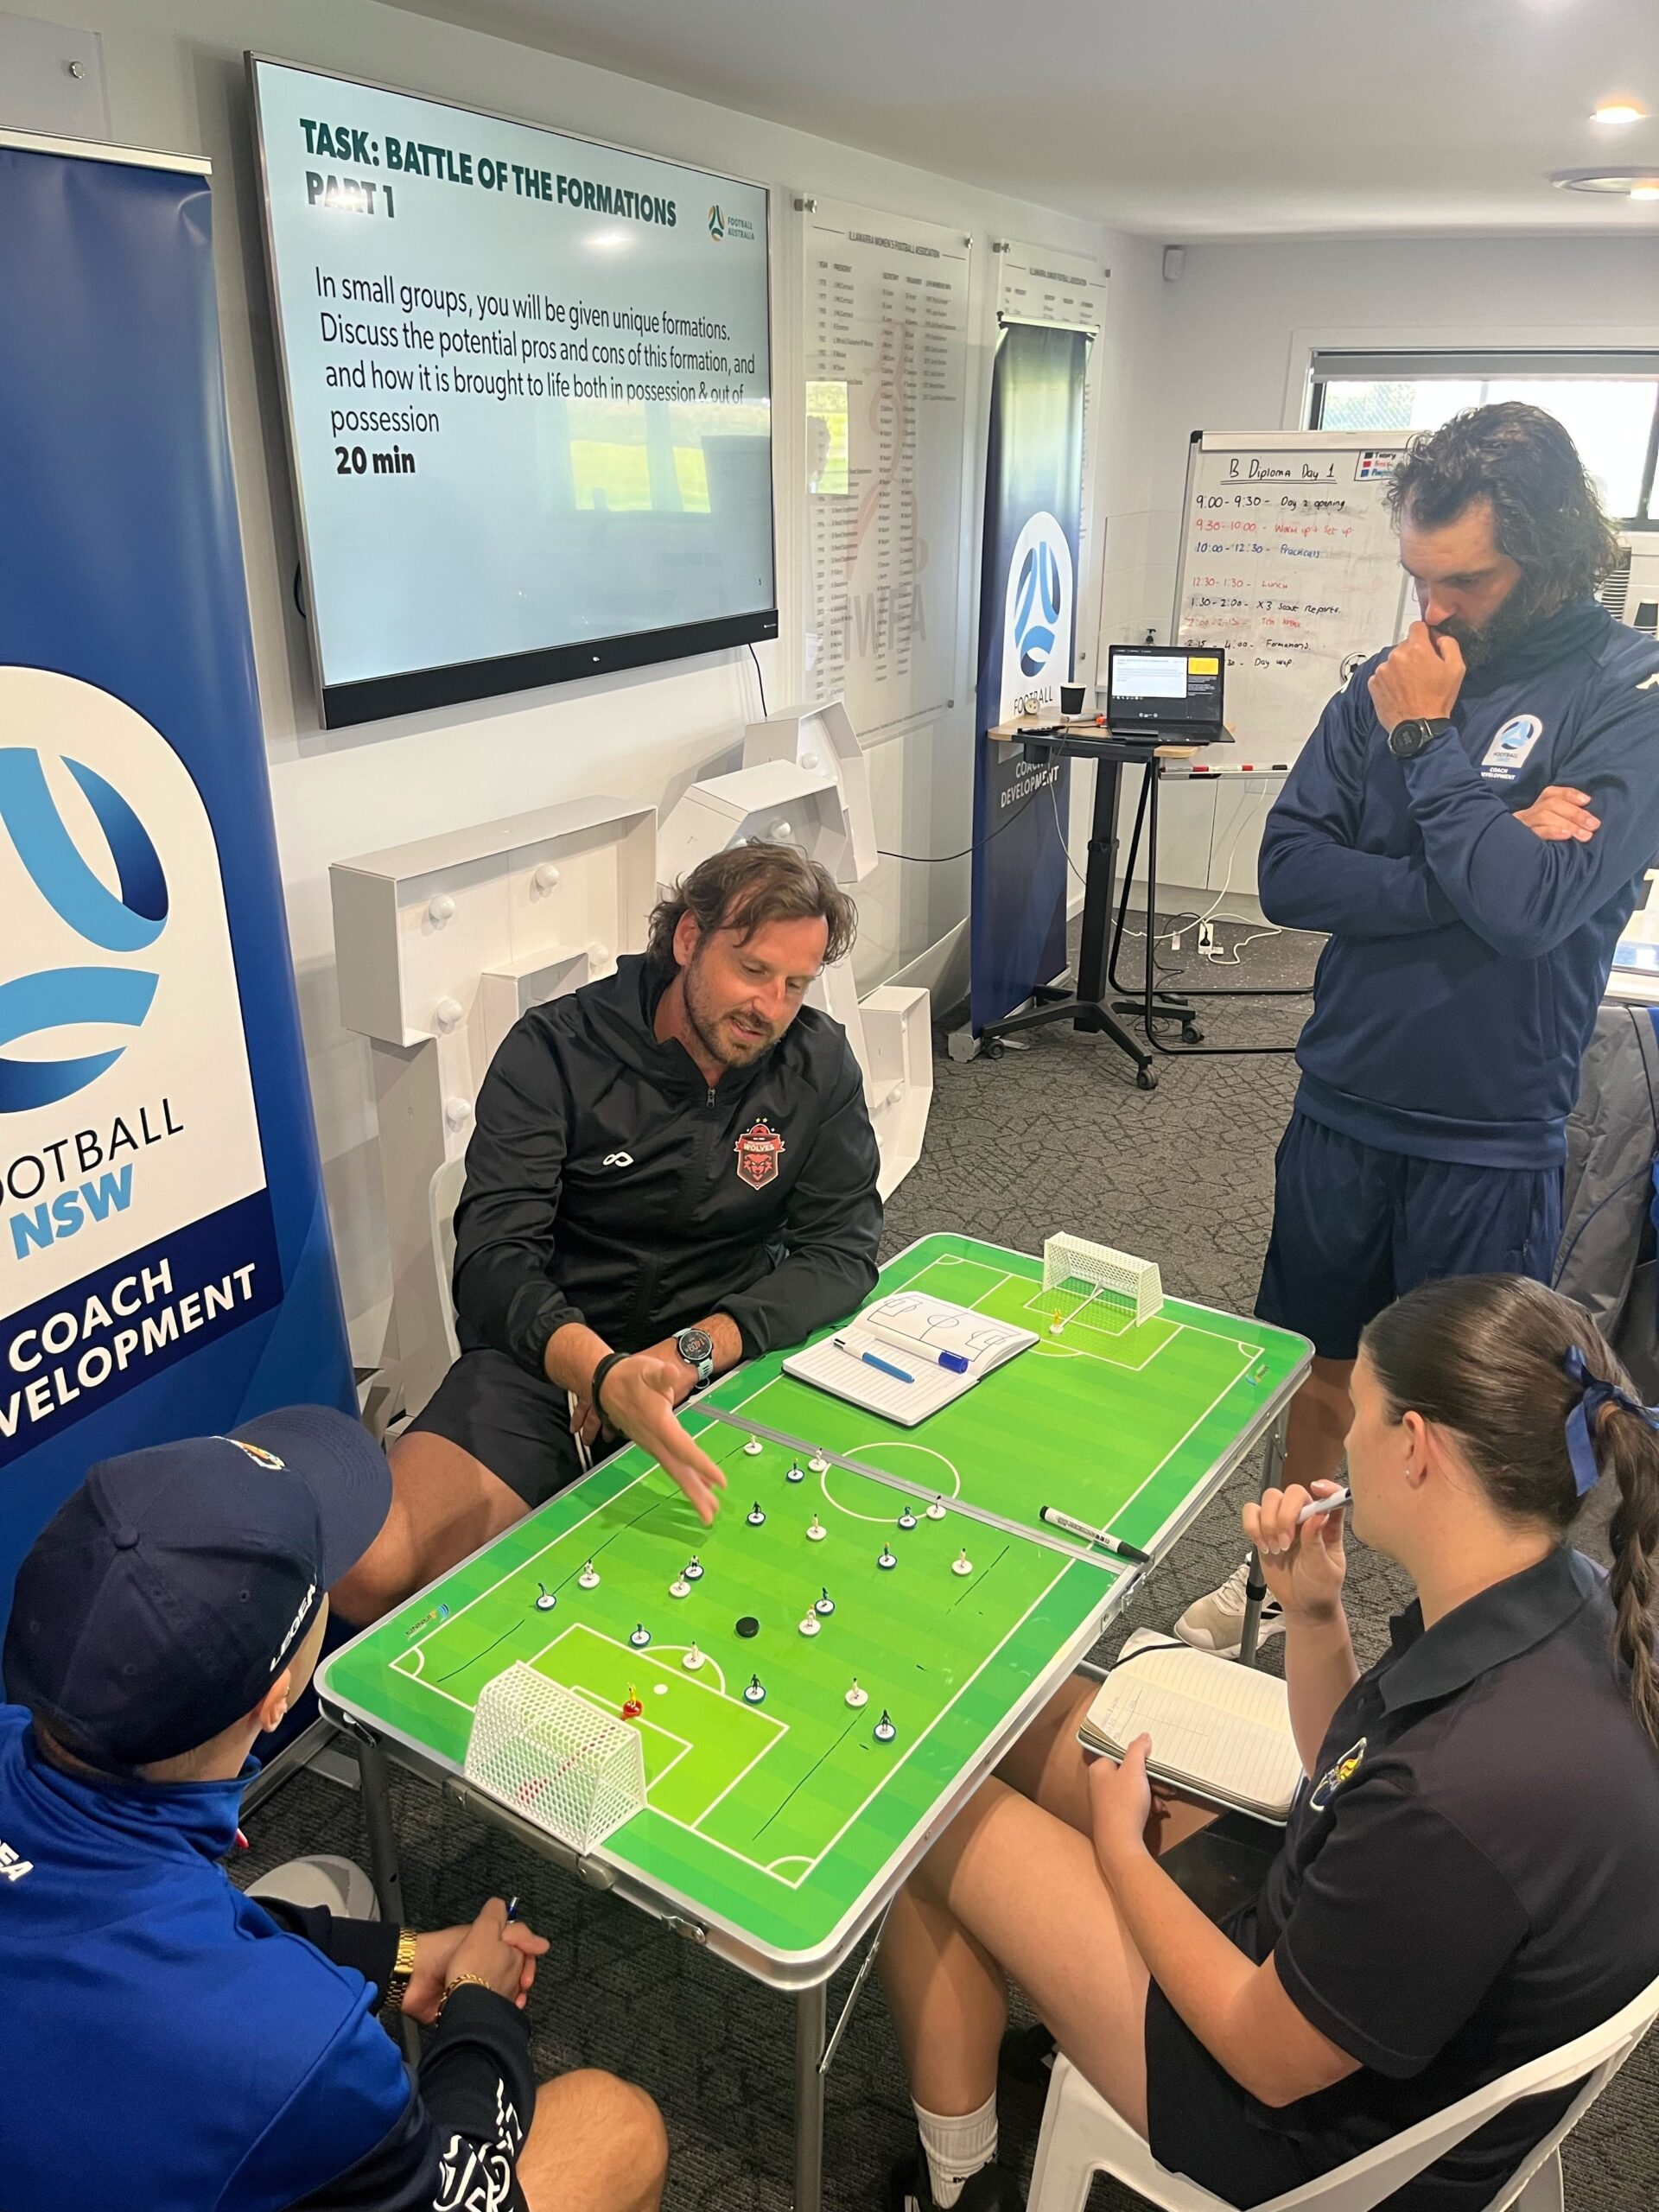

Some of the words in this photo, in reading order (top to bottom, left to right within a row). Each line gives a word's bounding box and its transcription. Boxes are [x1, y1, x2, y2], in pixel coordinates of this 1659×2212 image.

[300, 118, 380, 167] TASK:
[385, 137, 474, 186] BATTLE
[478, 157, 508, 192] OF
[512, 164, 553, 202] THE
[556, 175, 677, 227] FORMATIONS
[305, 170, 377, 215] PART
[383, 184, 395, 219] 1
[728, 217, 753, 231] FOOTBALL
[728, 227, 755, 240] AUSTRALIA
[315, 266, 336, 298] In
[342, 275, 395, 304] small
[400, 285, 473, 318] groups,
[476, 294, 509, 321] you
[512, 294, 541, 321] will
[545, 296, 565, 322] be
[569, 300, 609, 330] given
[613, 307, 659, 337] unique
[662, 311, 730, 341] formations.
[321, 311, 398, 347] Discuss
[403, 321, 434, 350] the
[439, 328, 517, 358] potential
[521, 338, 556, 363] pros
[560, 338, 588, 363] and
[592, 345, 625, 365] cons
[628, 342, 642, 366] of
[644, 344, 667, 368] this
[670, 346, 732, 376] formation,
[734, 353, 755, 374] and
[325, 359, 365, 388] and
[371, 360, 414, 391] how
[418, 364, 432, 391] it
[435, 365, 449, 392] is
[454, 365, 524, 401] brought
[527, 372, 544, 397] to
[547, 372, 569, 397] life
[574, 373, 607, 399] both
[610, 376, 623, 400] in
[626, 380, 696, 406] possession
[698, 381, 709, 404] &
[710, 385, 730, 404] out
[732, 384, 744, 404] of
[330, 404, 439, 438] possession
[334, 446, 367, 474] 20
[372, 445, 416, 474] min
[1230, 458, 1239, 478] B
[1249, 459, 1291, 480] Diploma
[1302, 463, 1319, 480] Day
[1326, 462, 1334, 478] 1
[1281, 496, 1298, 511] Day
[1313, 499, 1345, 512] opening
[1255, 658, 1270, 669] Day
[1001, 765, 1060, 809] DEVELOPMENT
[0, 1097, 185, 1206] OTBALL
[744, 1142, 775, 1152] WOLVES
[9, 1162, 134, 1261] NSW
[8, 1257, 174, 1373] COACH
[0, 1262, 257, 1439] VELOPMENT
